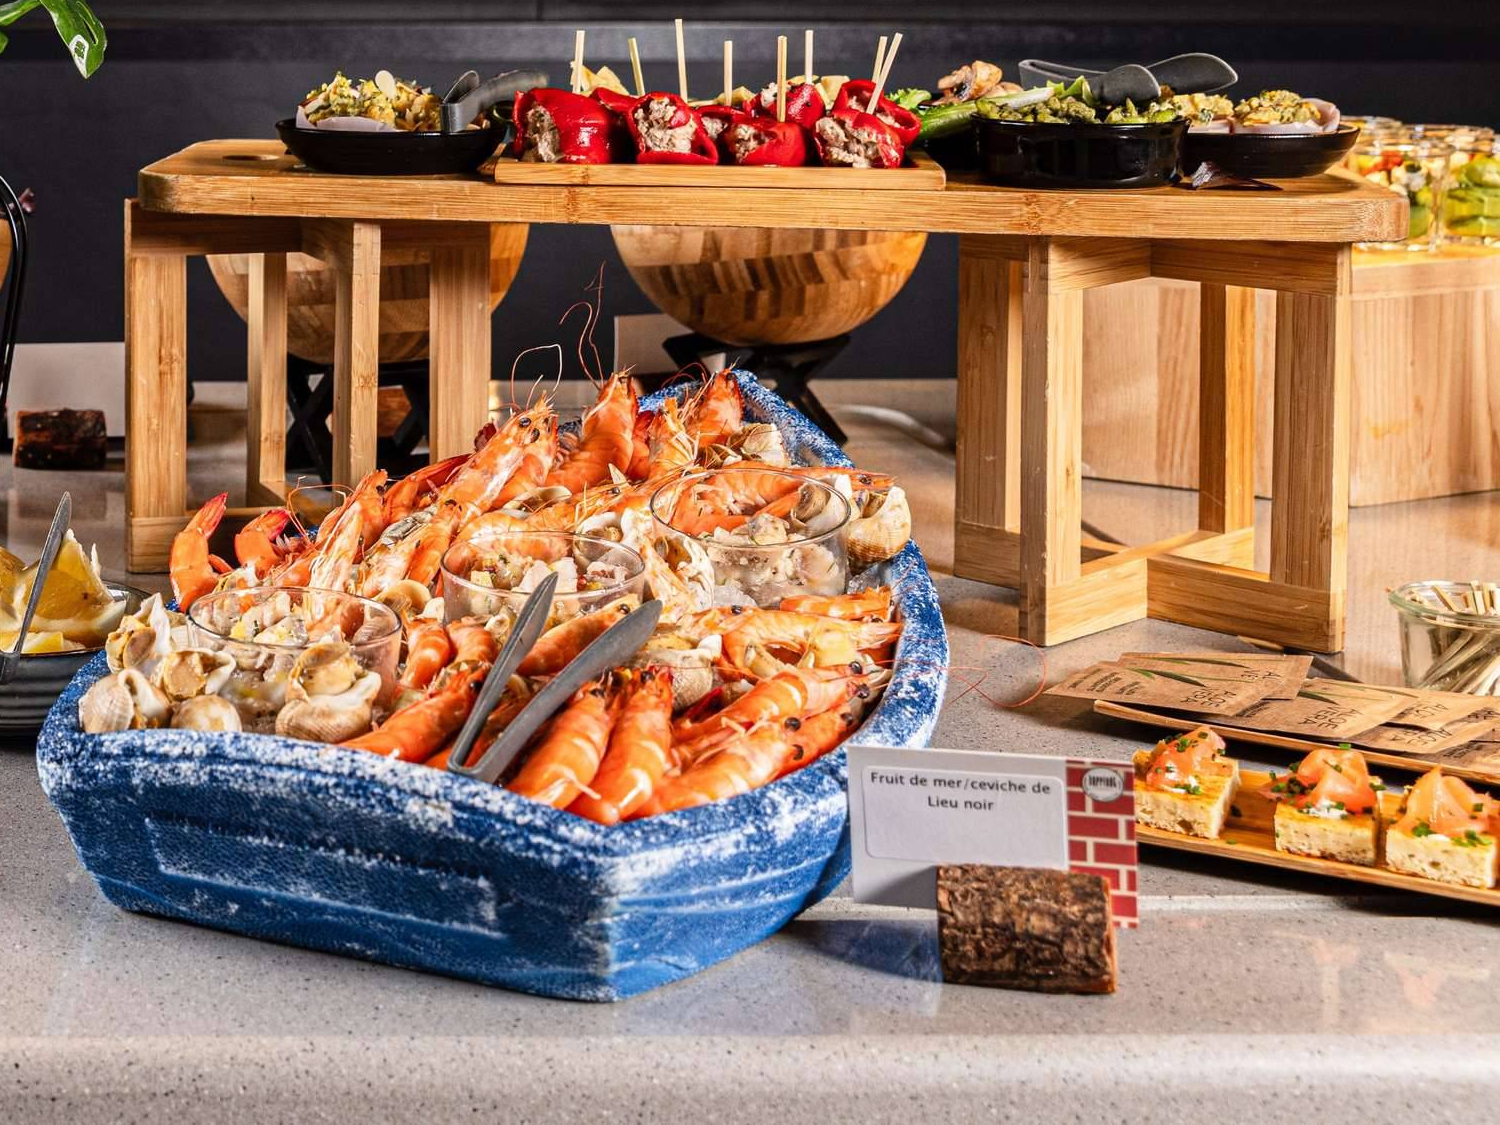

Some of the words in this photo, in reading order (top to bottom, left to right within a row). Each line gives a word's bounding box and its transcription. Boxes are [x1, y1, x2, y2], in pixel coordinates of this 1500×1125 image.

[1298, 706, 1341, 724] VERA
[1318, 708, 1363, 729] ALOE
[870, 771, 905, 786] Fruit
[909, 774, 928, 786] de
[933, 777, 1027, 793] mer/ceviche
[1031, 781, 1051, 794] de
[927, 795, 959, 809] Lieu
[963, 798, 994, 811] noir
